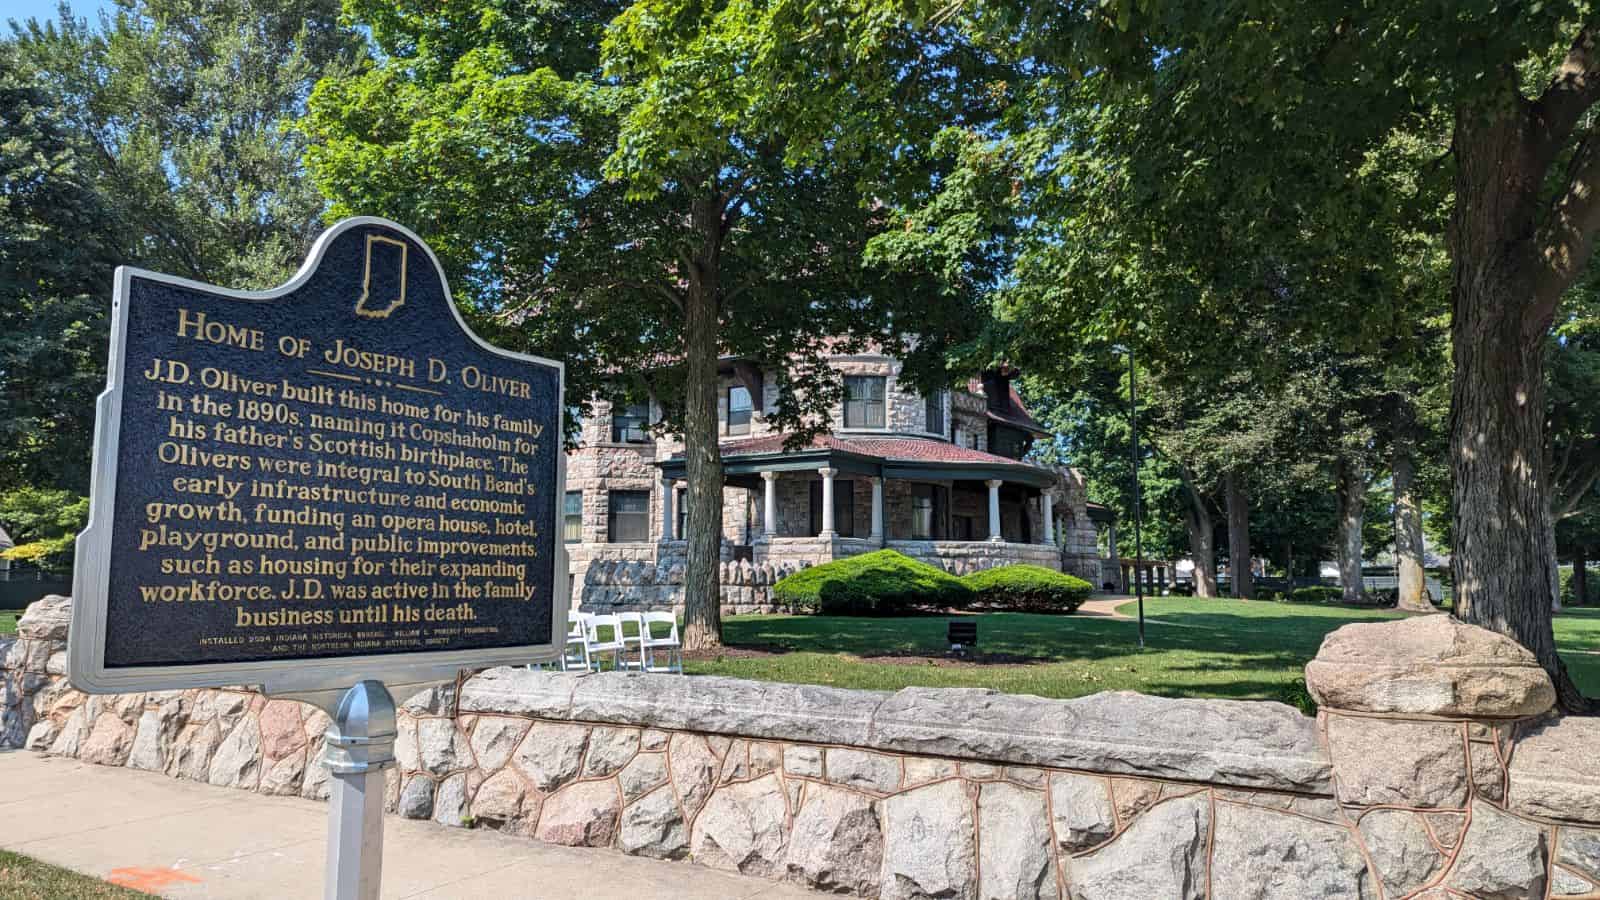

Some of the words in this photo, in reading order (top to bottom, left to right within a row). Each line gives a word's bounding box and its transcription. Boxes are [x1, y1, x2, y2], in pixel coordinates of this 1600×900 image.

[145, 358, 193, 387] J.D.
[201, 368, 277, 396] Oliver
[282, 380, 333, 406] built
[339, 389, 375, 411] this
[381, 394, 429, 418] home
[433, 404, 460, 423] for
[466, 407, 489, 427] his
[494, 413, 544, 439] family
[157, 391, 187, 411] in
[192, 396, 232, 418] the
[310, 414, 385, 439] naming
[390, 420, 404, 439] it
[409, 423, 510, 453] Copshaholm
[514, 436, 539, 455] for
[169, 415, 206, 439] his
[213, 422, 303, 450] father's
[309, 434, 396, 459] Scottish
[400, 442, 495, 473] birthplace.
[498, 455, 529, 475] The
[159, 442, 251, 469] Olivers
[258, 456, 311, 473] were
[318, 460, 401, 485] integral
[405, 468, 425, 486] to
[429, 471, 480, 491] South
[484, 476, 535, 496] Bend's
[173, 474, 242, 500] early
[251, 480, 410, 508] infrastructure
[414, 491, 446, 510] and
[451, 496, 525, 515] economic
[254, 503, 345, 530] funding
[351, 512, 375, 529] an
[382, 513, 435, 536] opera
[304, 533, 344, 552] and
[351, 534, 413, 556] public
[160, 554, 219, 575] such
[227, 558, 253, 576] as
[259, 555, 348, 579] housing
[353, 558, 384, 577] for
[389, 558, 436, 577] their
[439, 560, 525, 580] expanding
[140, 581, 276, 603] workforce.
[281, 579, 325, 600] J.D.
[331, 583, 368, 600] was
[371, 581, 428, 600] active
[432, 581, 449, 599] in
[454, 581, 481, 599] the
[484, 580, 535, 602] family
[235, 606, 333, 628] business
[339, 605, 387, 624] until
[392, 604, 421, 623] his
[424, 604, 478, 623] death.
